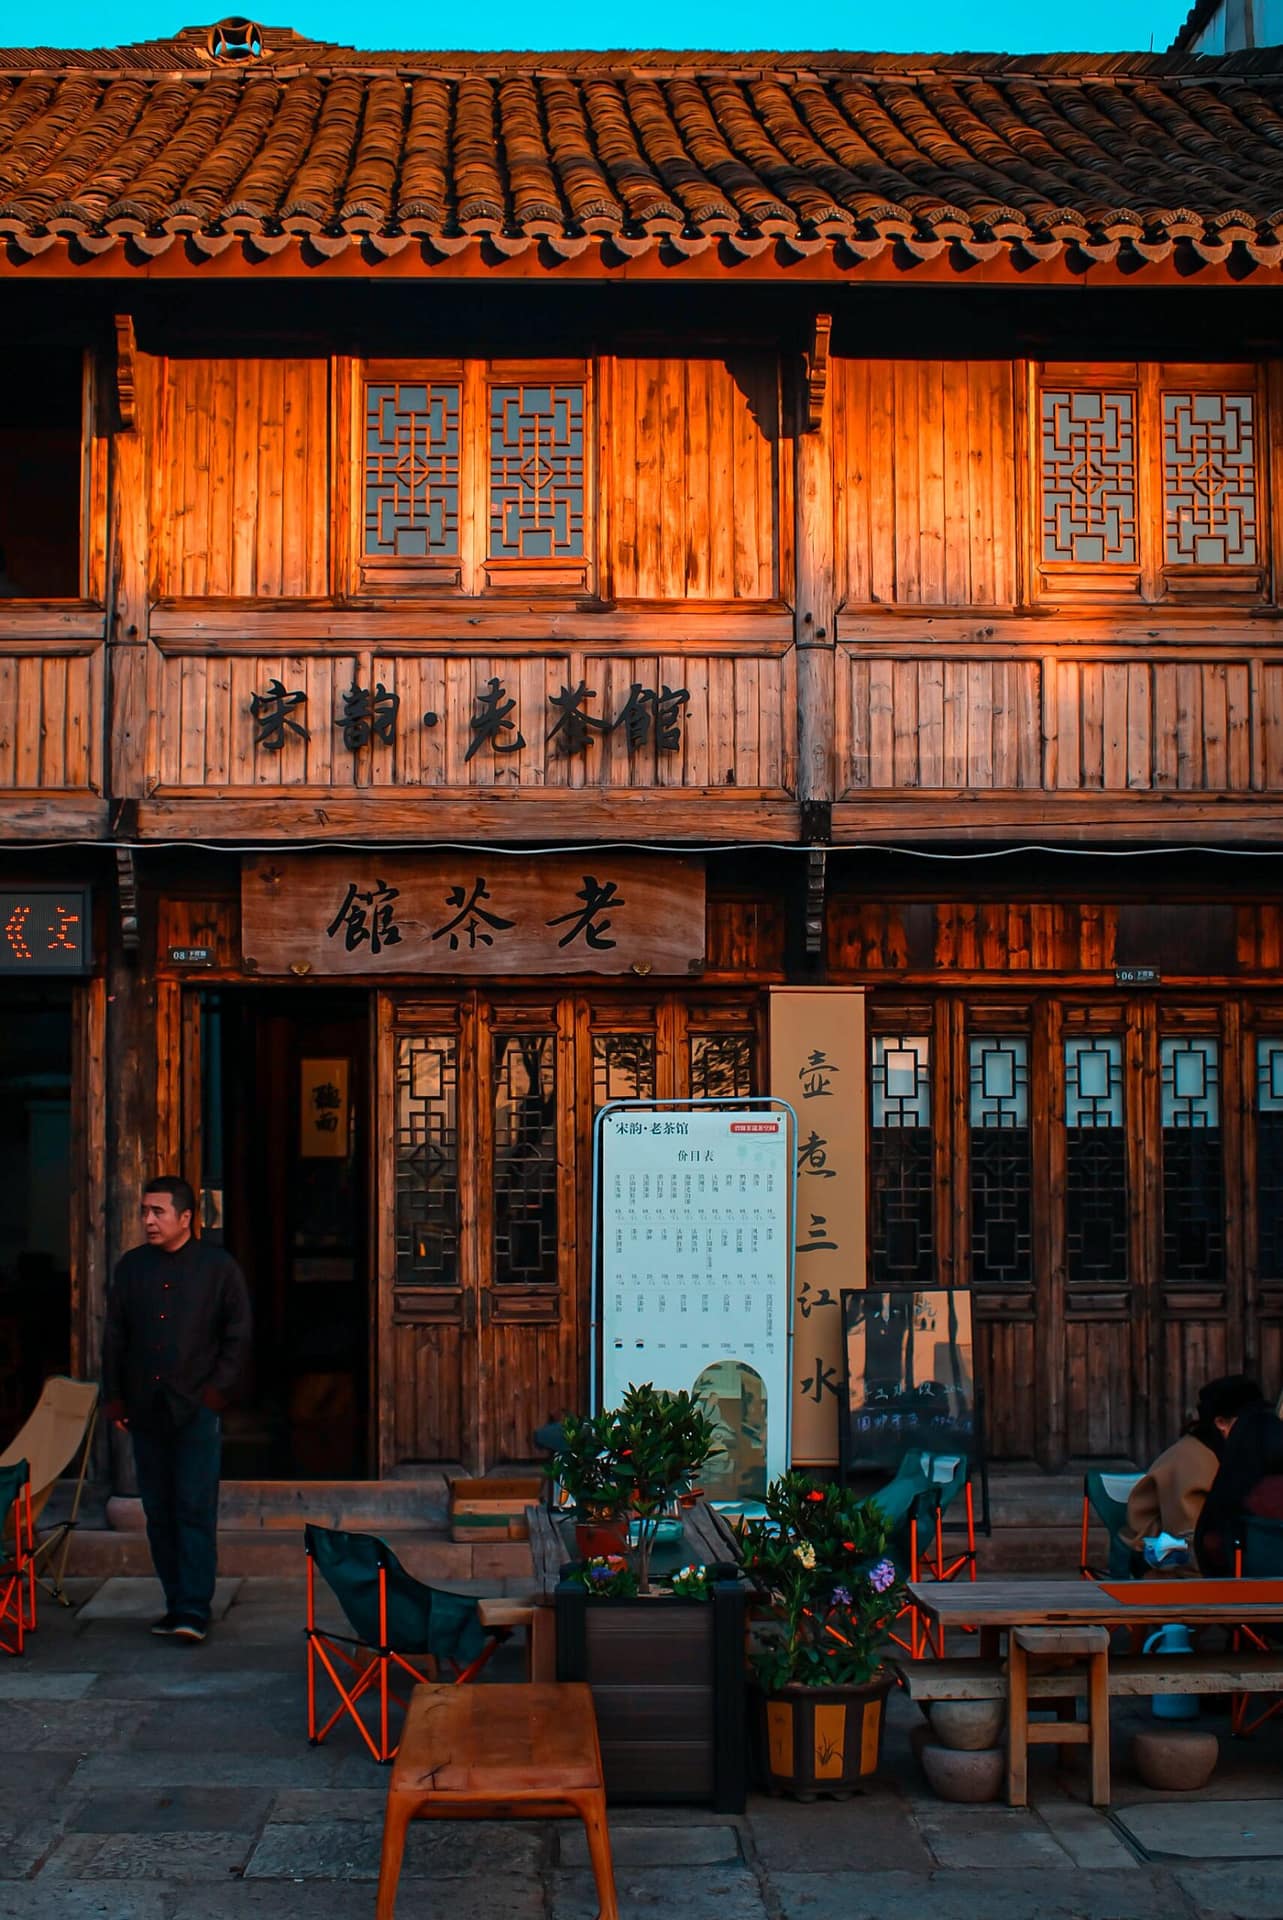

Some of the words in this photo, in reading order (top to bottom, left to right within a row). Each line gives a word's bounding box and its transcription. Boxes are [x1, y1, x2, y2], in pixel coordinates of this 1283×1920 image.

[326, 875, 625, 954] 老茶館
[1121, 971, 1134, 981] 06
